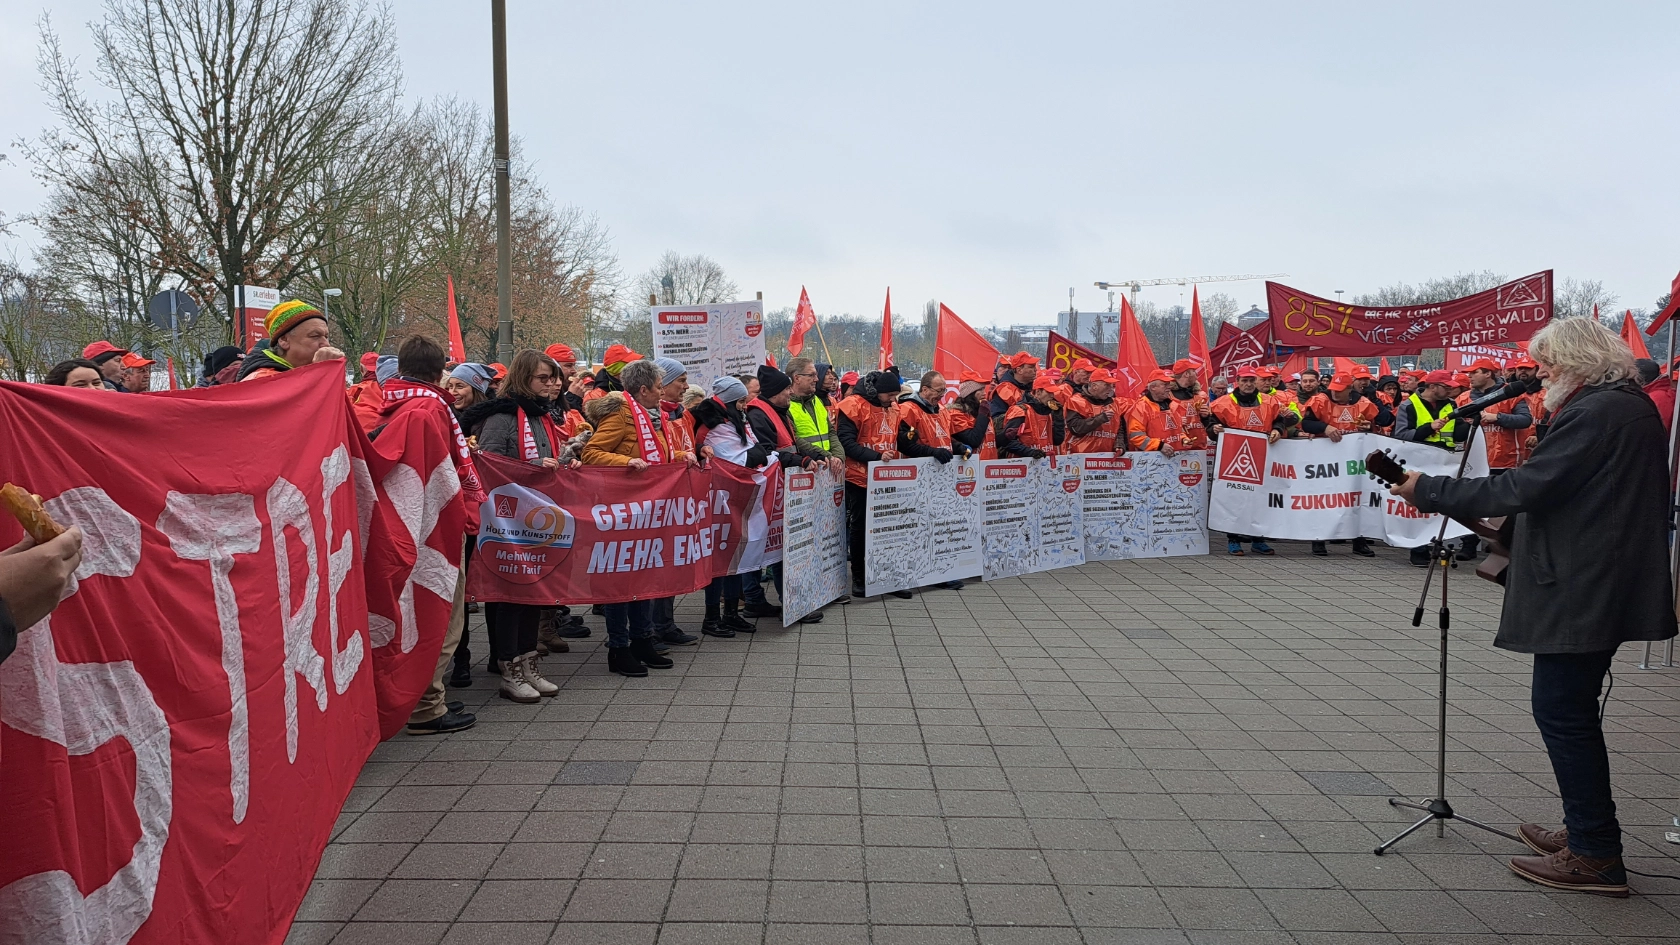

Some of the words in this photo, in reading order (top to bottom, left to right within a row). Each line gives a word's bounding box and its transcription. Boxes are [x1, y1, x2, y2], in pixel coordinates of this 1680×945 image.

[1364, 310, 1402, 320] MEHR
[1406, 306, 1442, 319] LOHN
[1437, 307, 1546, 335] BAYERWALD
[1440, 327, 1509, 346] FENSTER
[1085, 460, 1098, 468] WIR
[1270, 462, 1298, 479] MIA
[1304, 462, 1340, 479] SAN
[989, 468, 1000, 476] WIR
[1226, 482, 1255, 492] PASSAU
[1268, 492, 1284, 508] IN
[1290, 491, 1363, 510] ZUKUNFT
[495, 550, 547, 562] MehrWert
[586, 537, 664, 573] MEHR
[498, 563, 519, 574] mit
[521, 564, 542, 575] Tarif
